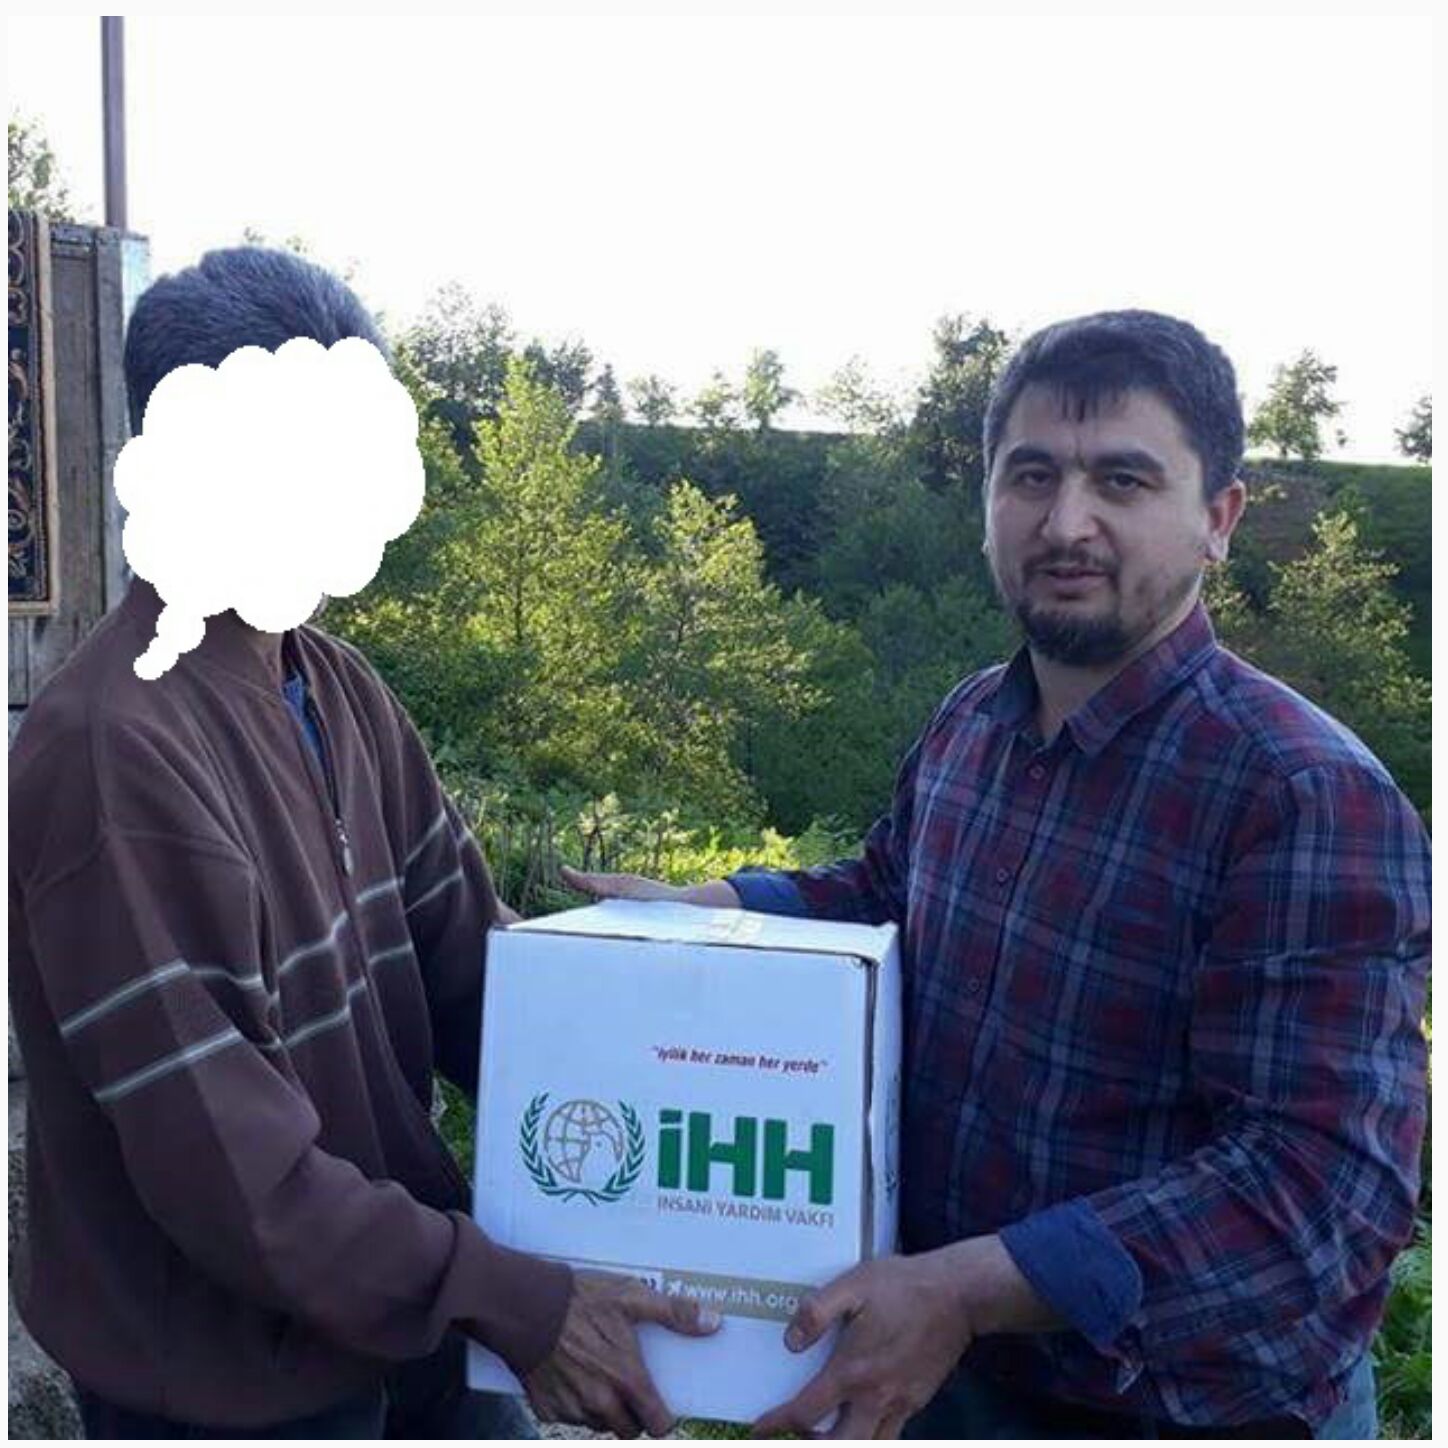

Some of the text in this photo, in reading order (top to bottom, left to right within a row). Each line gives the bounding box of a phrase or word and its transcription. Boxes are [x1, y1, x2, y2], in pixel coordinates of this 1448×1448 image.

[658, 1109, 835, 1205] iHH
[715, 1202, 782, 1222] YARDIM
[784, 1209, 835, 1228] VAKFI
